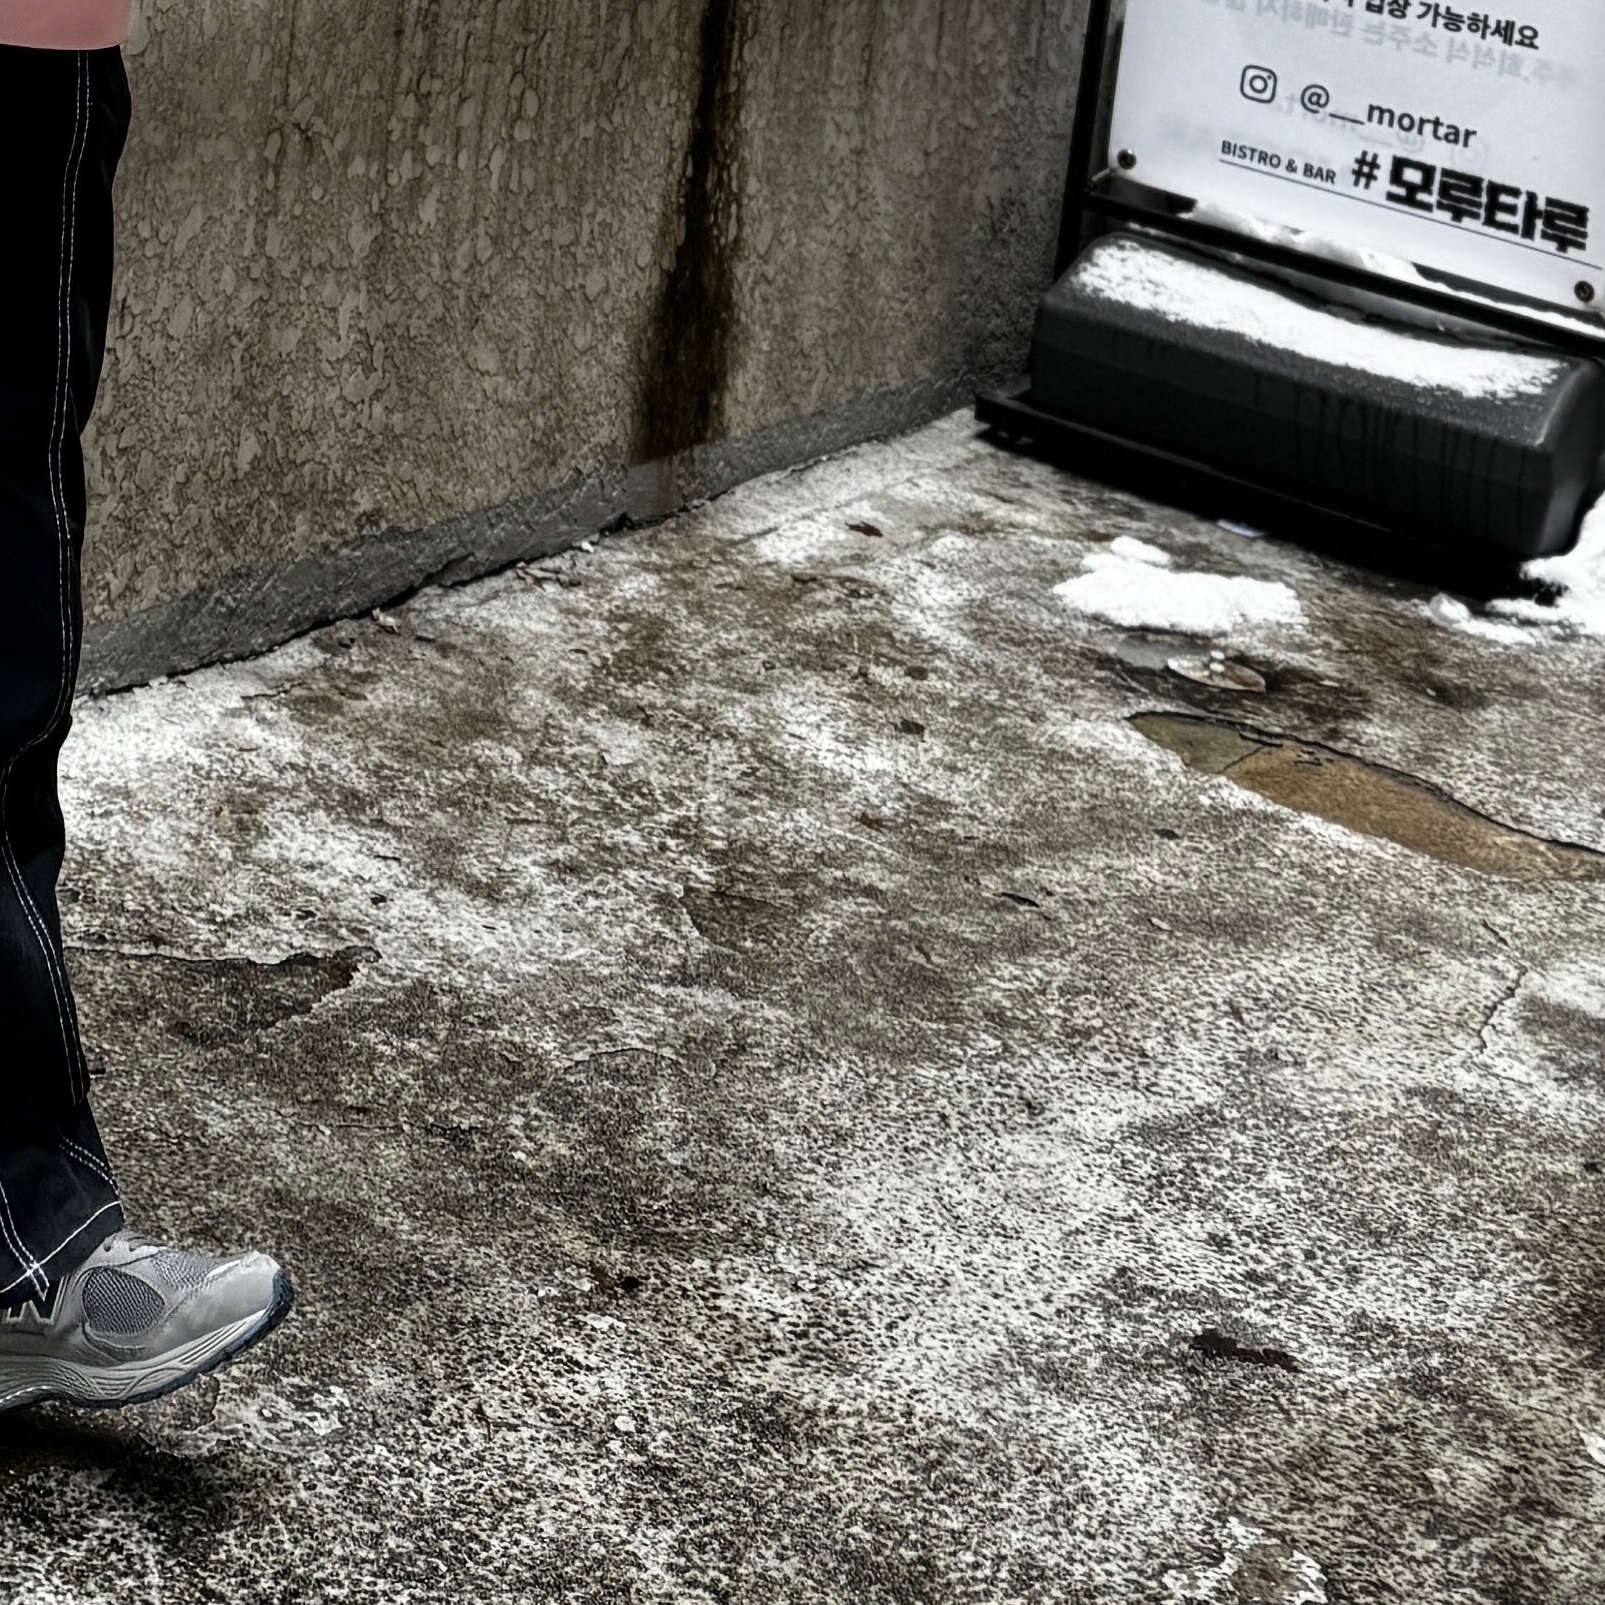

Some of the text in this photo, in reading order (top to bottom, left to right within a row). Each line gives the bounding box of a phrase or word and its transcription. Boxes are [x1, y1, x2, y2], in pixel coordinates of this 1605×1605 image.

[1417, 1, 1539, 49] 가능하세요
[1221, 140, 1281, 168] BISTRO
[1285, 159, 1297, 173] &
[1303, 163, 1336, 185] BAR
